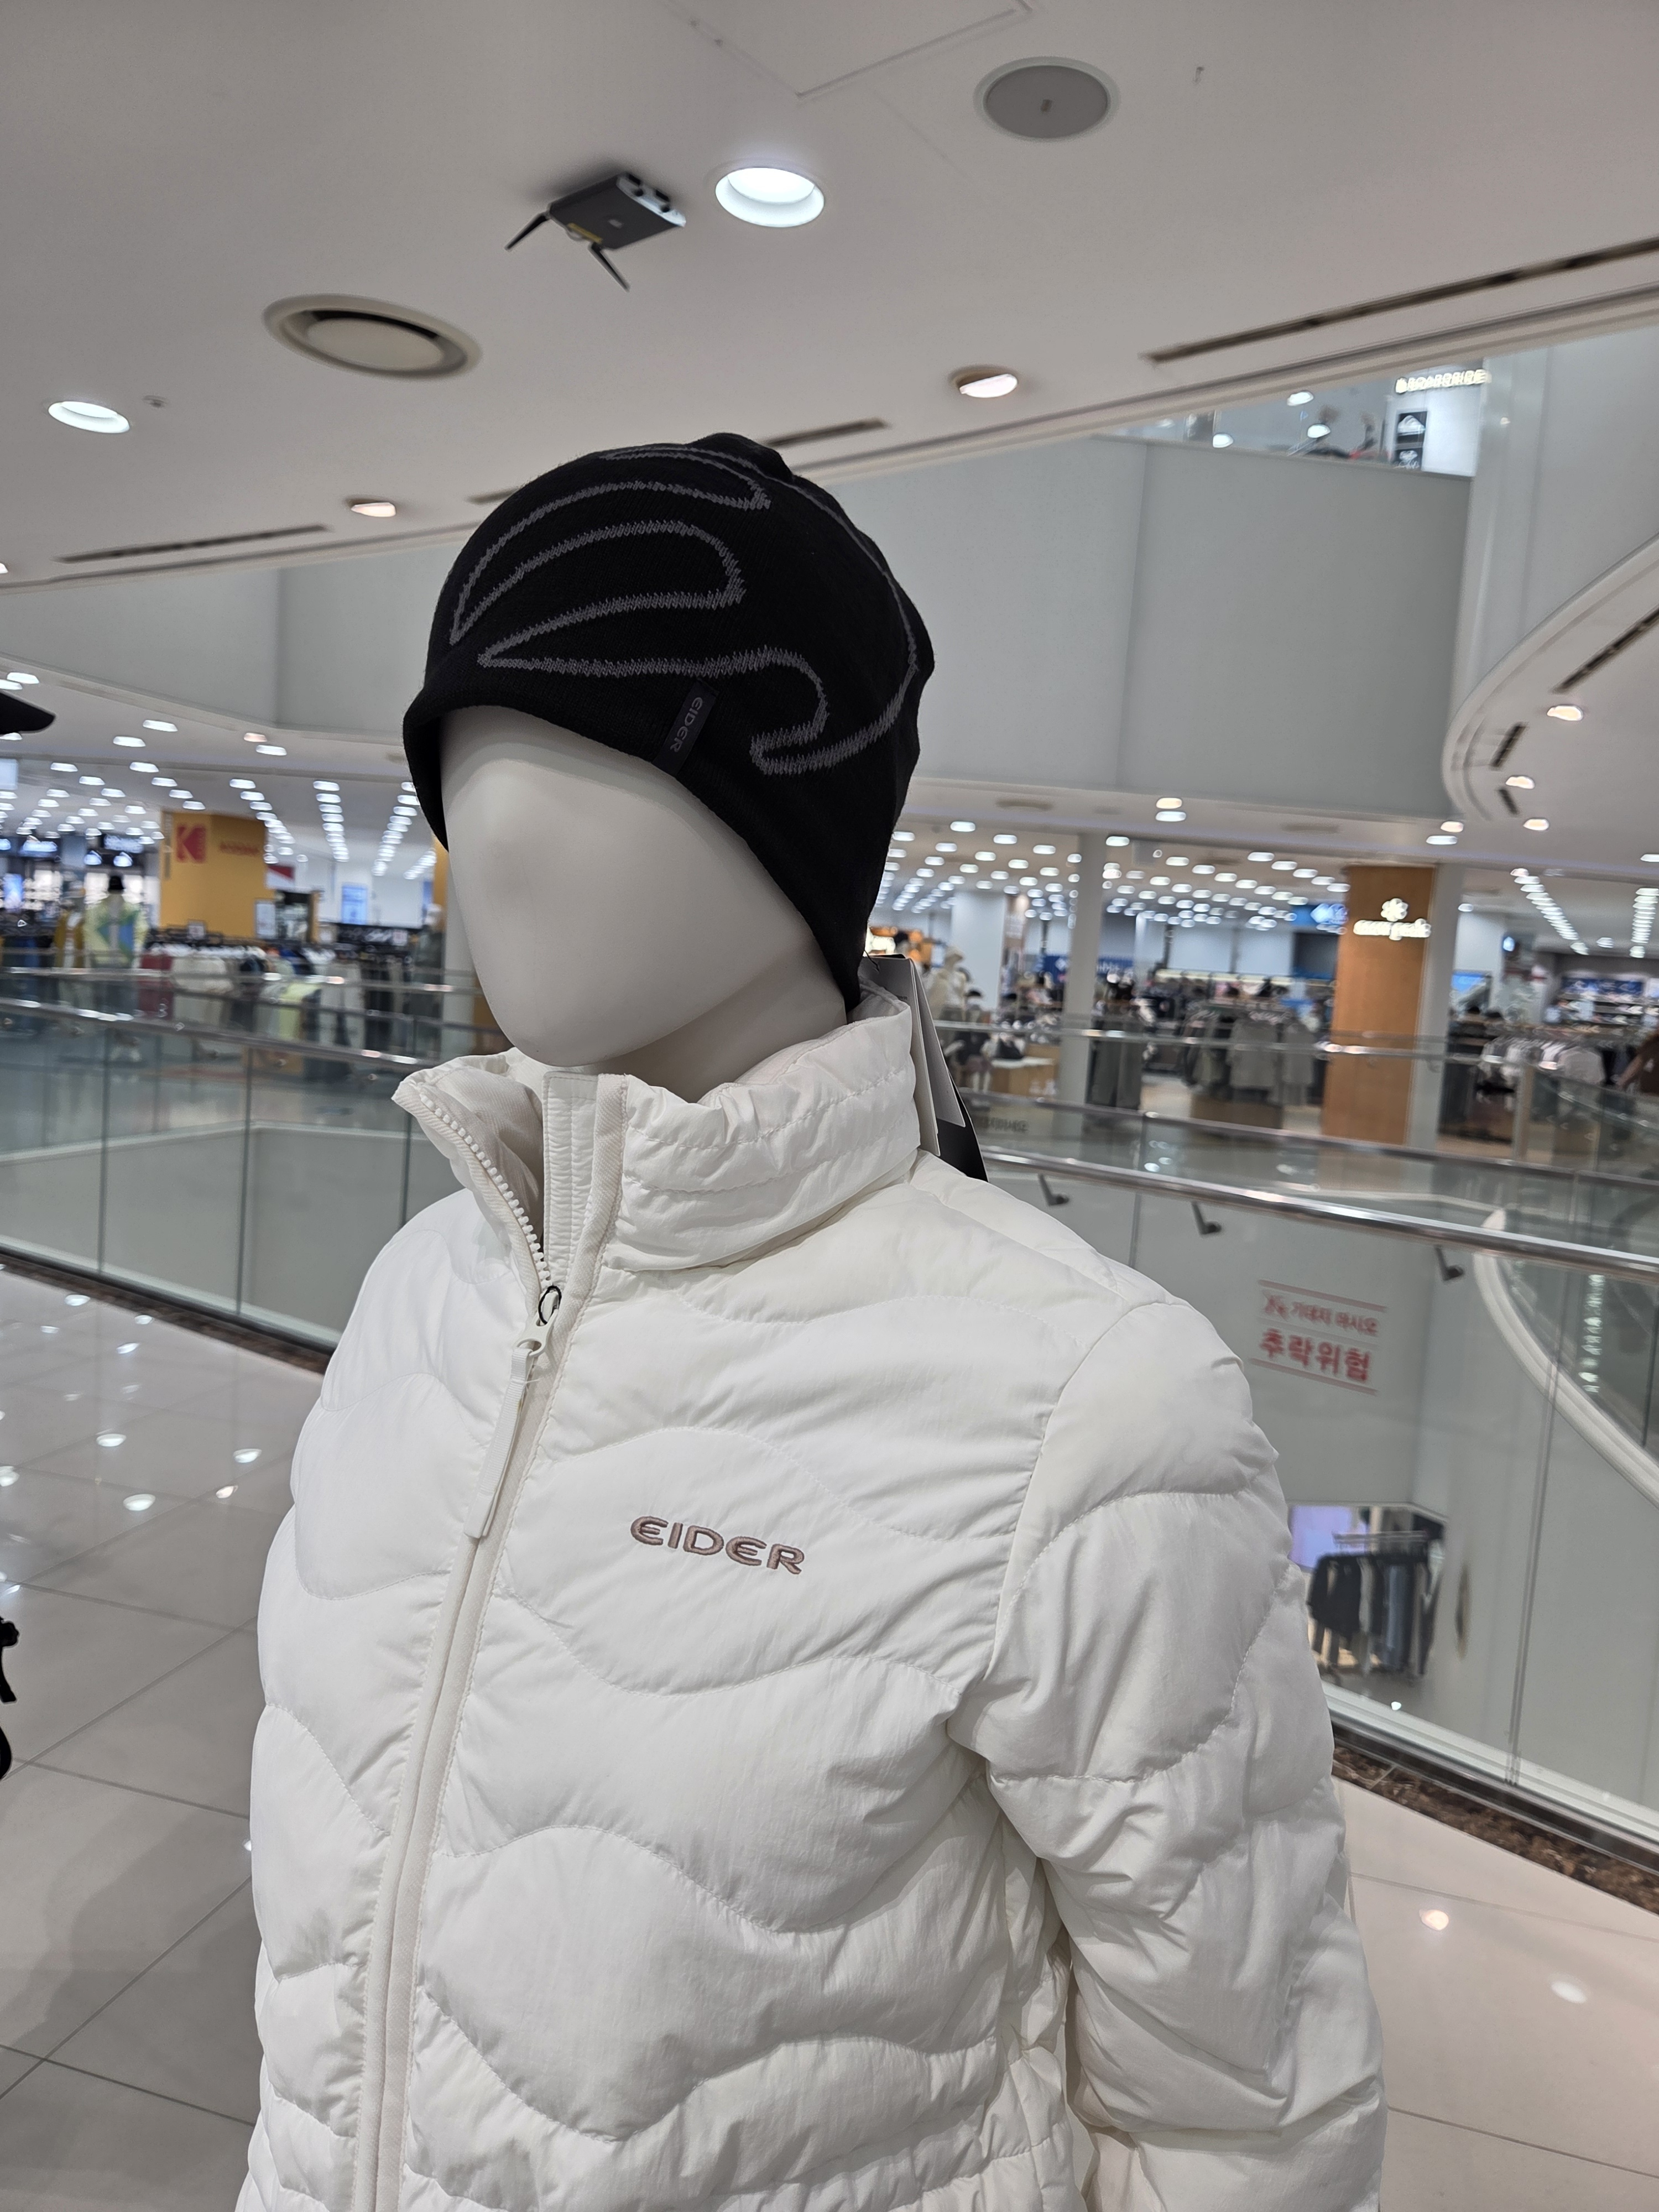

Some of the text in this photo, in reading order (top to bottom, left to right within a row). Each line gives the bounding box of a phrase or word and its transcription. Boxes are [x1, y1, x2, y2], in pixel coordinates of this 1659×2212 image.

[670, 697, 703, 753] EIDER
[1259, 1327, 1370, 1383] 추락위험
[630, 1516, 805, 1574] EIDER
